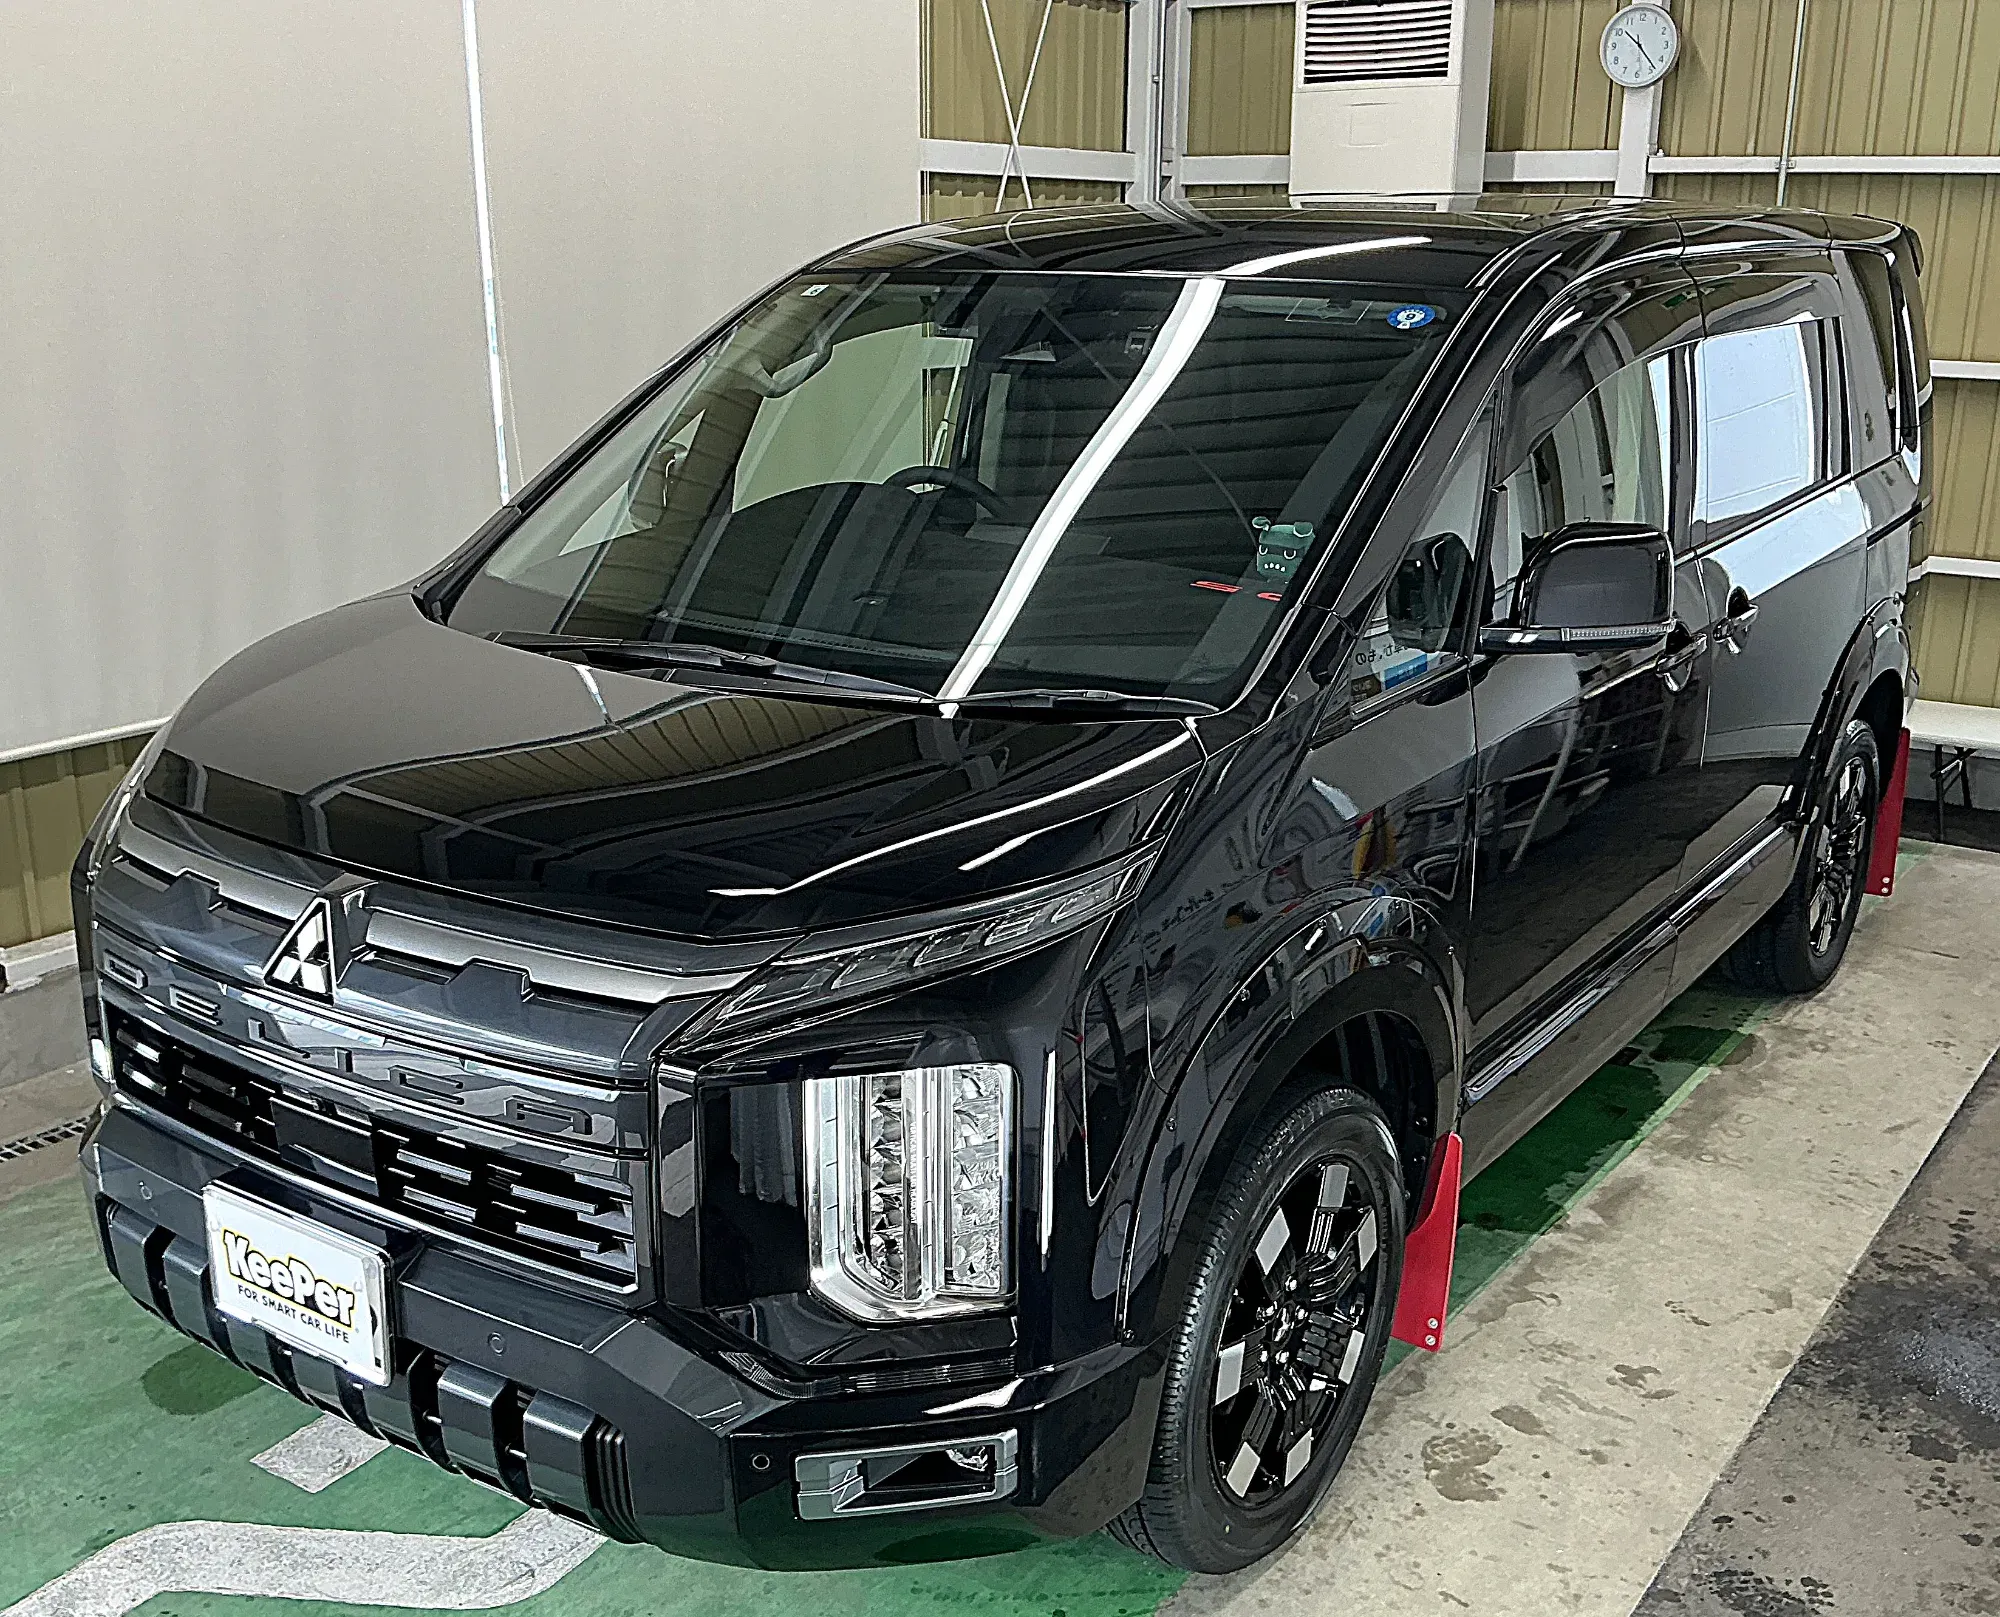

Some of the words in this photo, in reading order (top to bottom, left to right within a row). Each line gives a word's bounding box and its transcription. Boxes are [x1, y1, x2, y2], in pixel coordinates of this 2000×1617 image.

[1640, 12, 1646, 22] 12
[1626, 18, 1634, 26] 11
[1614, 28, 1624, 36] 10
[1661, 26, 1667, 36] 2
[1612, 42, 1617, 50] 9
[1664, 40, 1669, 50] 3
[1613, 56, 1619, 65] 8
[1658, 54, 1664, 63] 4
[1648, 66, 1654, 75] 5
[104, 950, 593, 1135] DELICA
[224, 1229, 355, 1328] KeePer
[238, 1284, 258, 1304] FOR
[262, 1295, 296, 1320] SMART
[300, 1313, 322, 1332] CAR
[324, 1322, 350, 1344] LIFE
